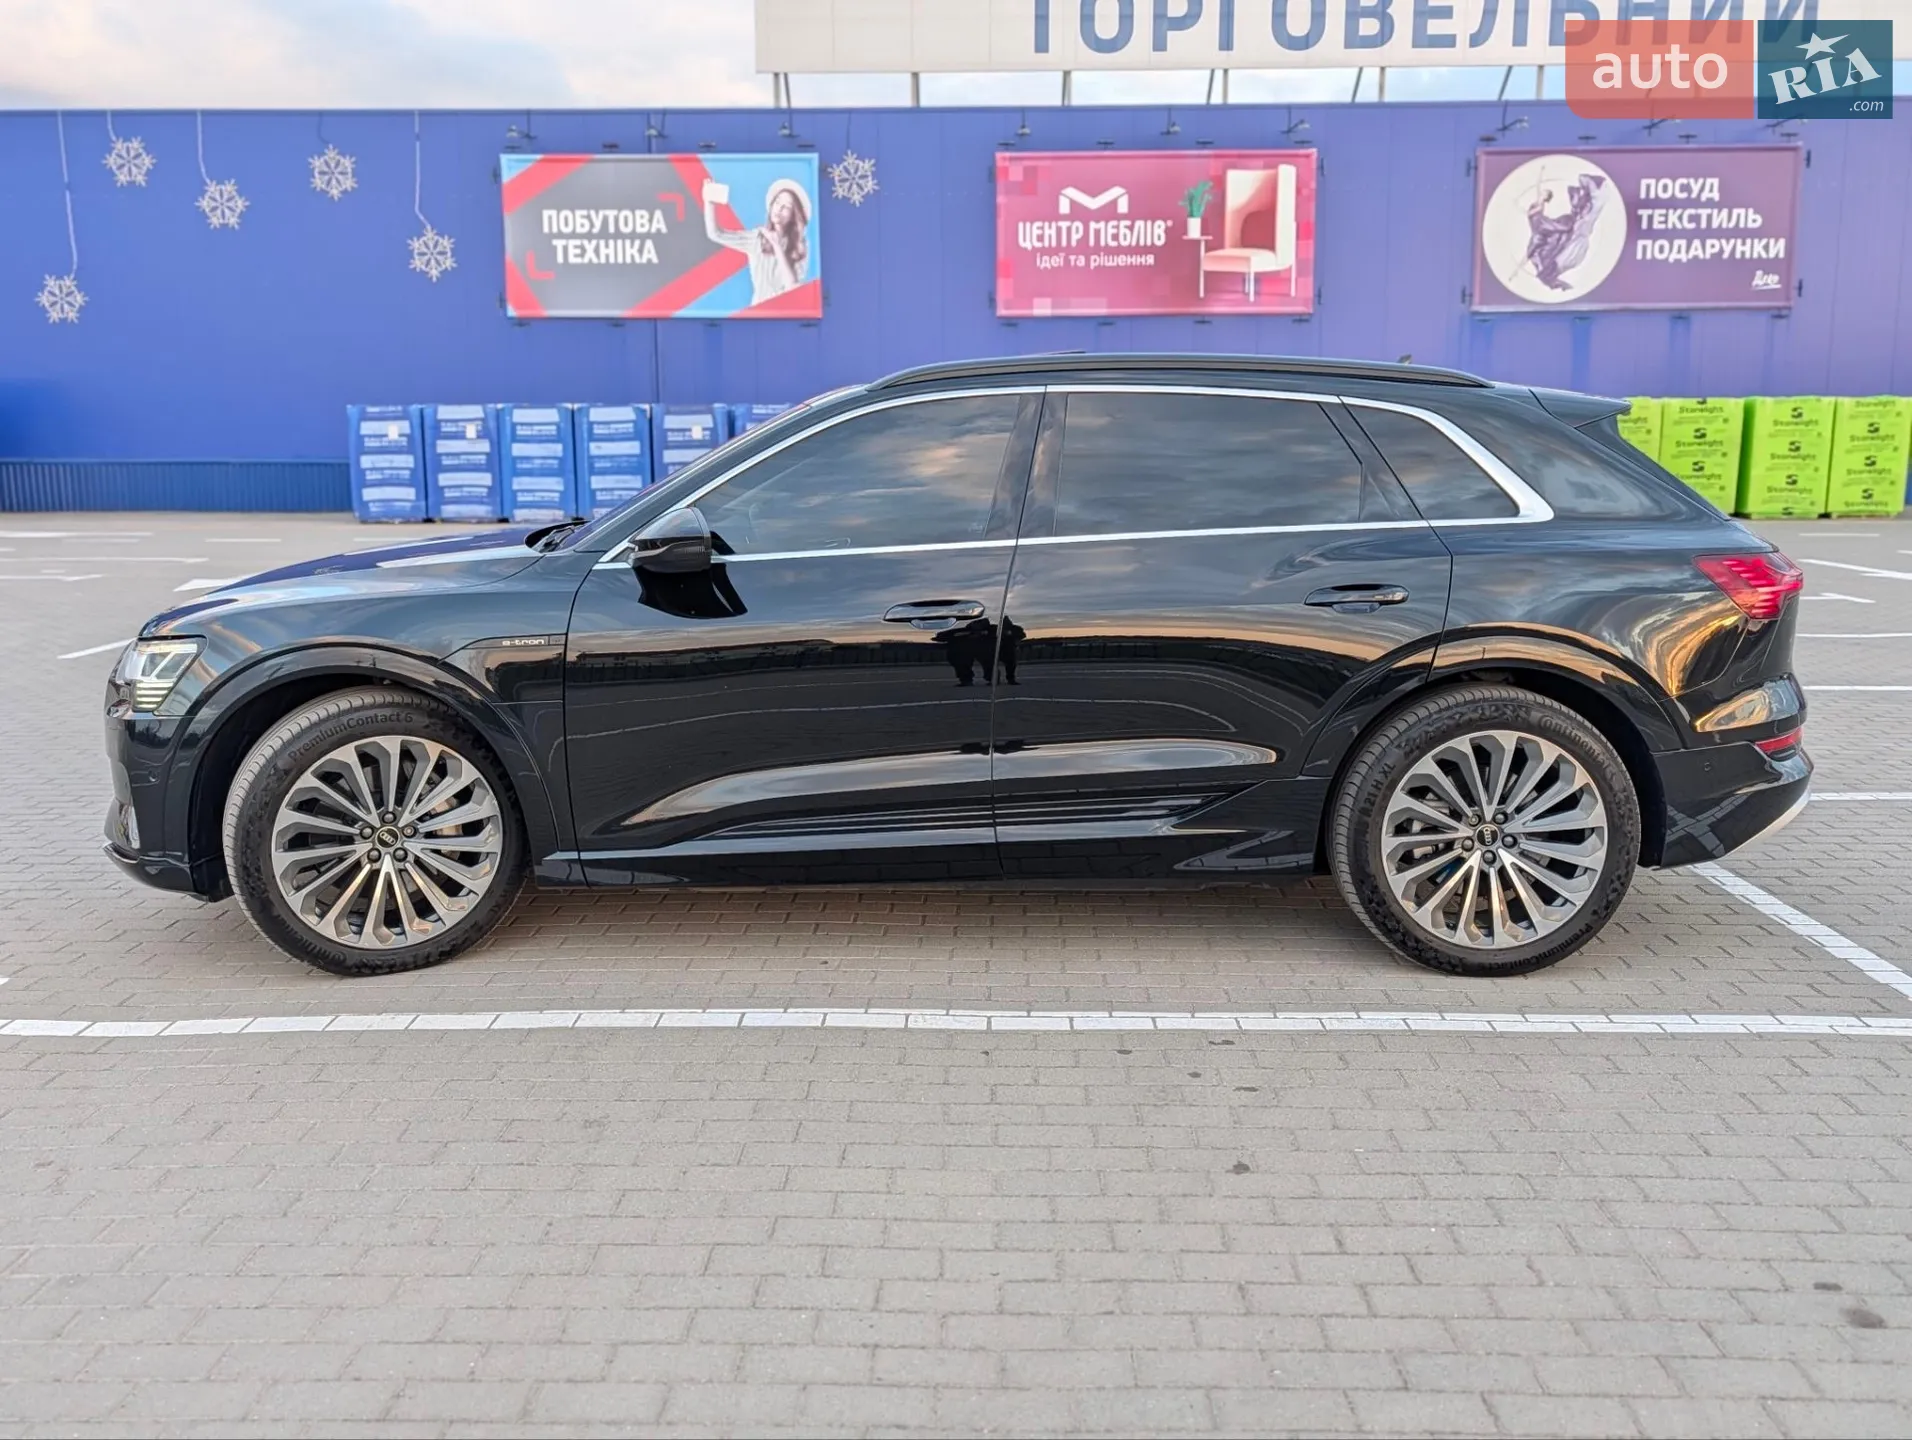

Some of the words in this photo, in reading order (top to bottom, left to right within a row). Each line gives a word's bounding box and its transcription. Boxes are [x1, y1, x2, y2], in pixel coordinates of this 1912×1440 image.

[1639, 177, 1720, 201] ПОСУД
[541, 209, 668, 234] ПОБУТОВА
[1637, 208, 1763, 230] ТЕКСТИЛЬ
[1017, 220, 1084, 250] ЦЕНТР
[551, 239, 659, 264] ТЕХНІКА
[1036, 252, 1066, 269] ідеї
[1068, 254, 1086, 267] та
[1089, 252, 1155, 269] рішення
[1635, 238, 1786, 263] ПОДАРУНКИ
[287, 712, 401, 761] PremiumContact
[405, 712, 414, 722] 6
[1379, 763, 1396, 779] XL
